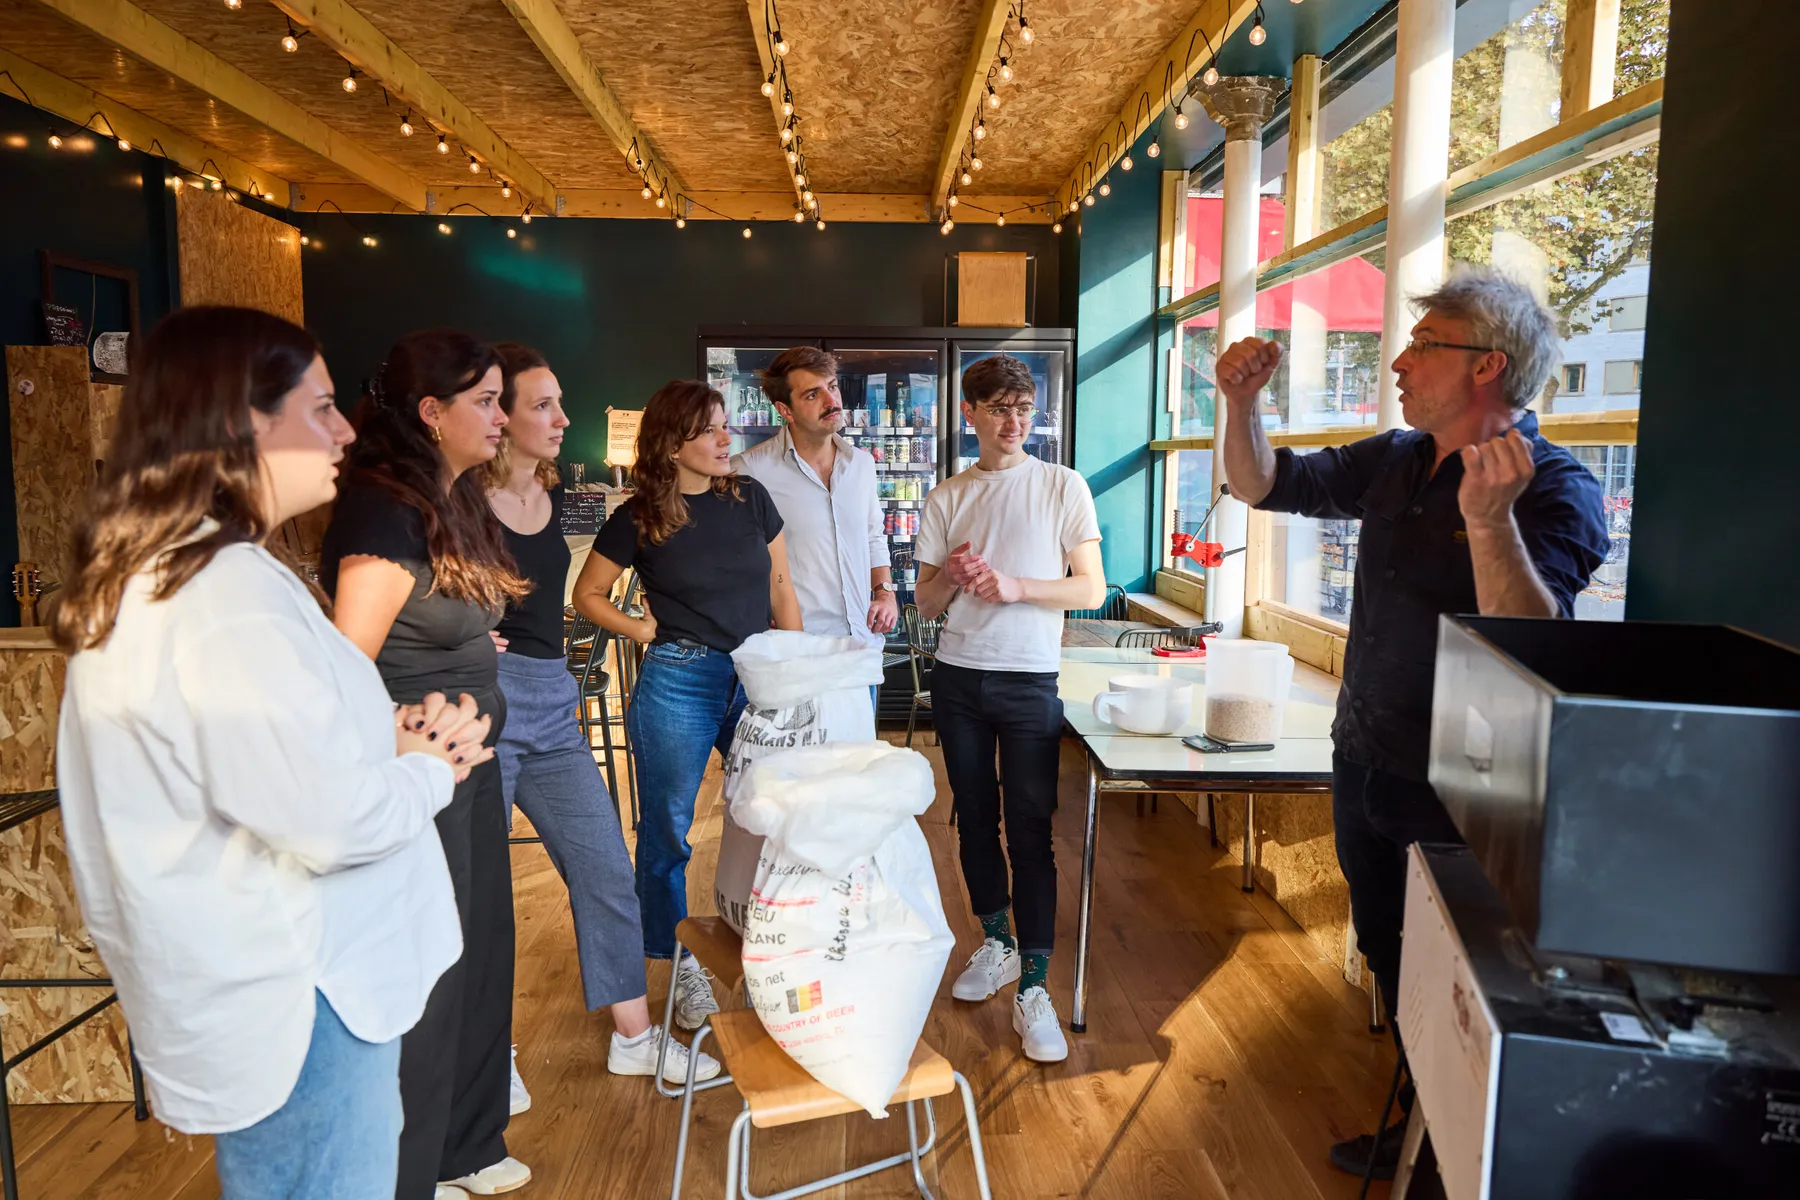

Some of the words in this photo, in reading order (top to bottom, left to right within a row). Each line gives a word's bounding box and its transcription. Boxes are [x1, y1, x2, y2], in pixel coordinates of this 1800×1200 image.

[764, 971, 785, 987] net
[773, 1019, 806, 1033] COUNTRY
[826, 1004, 855, 1020] BEER
